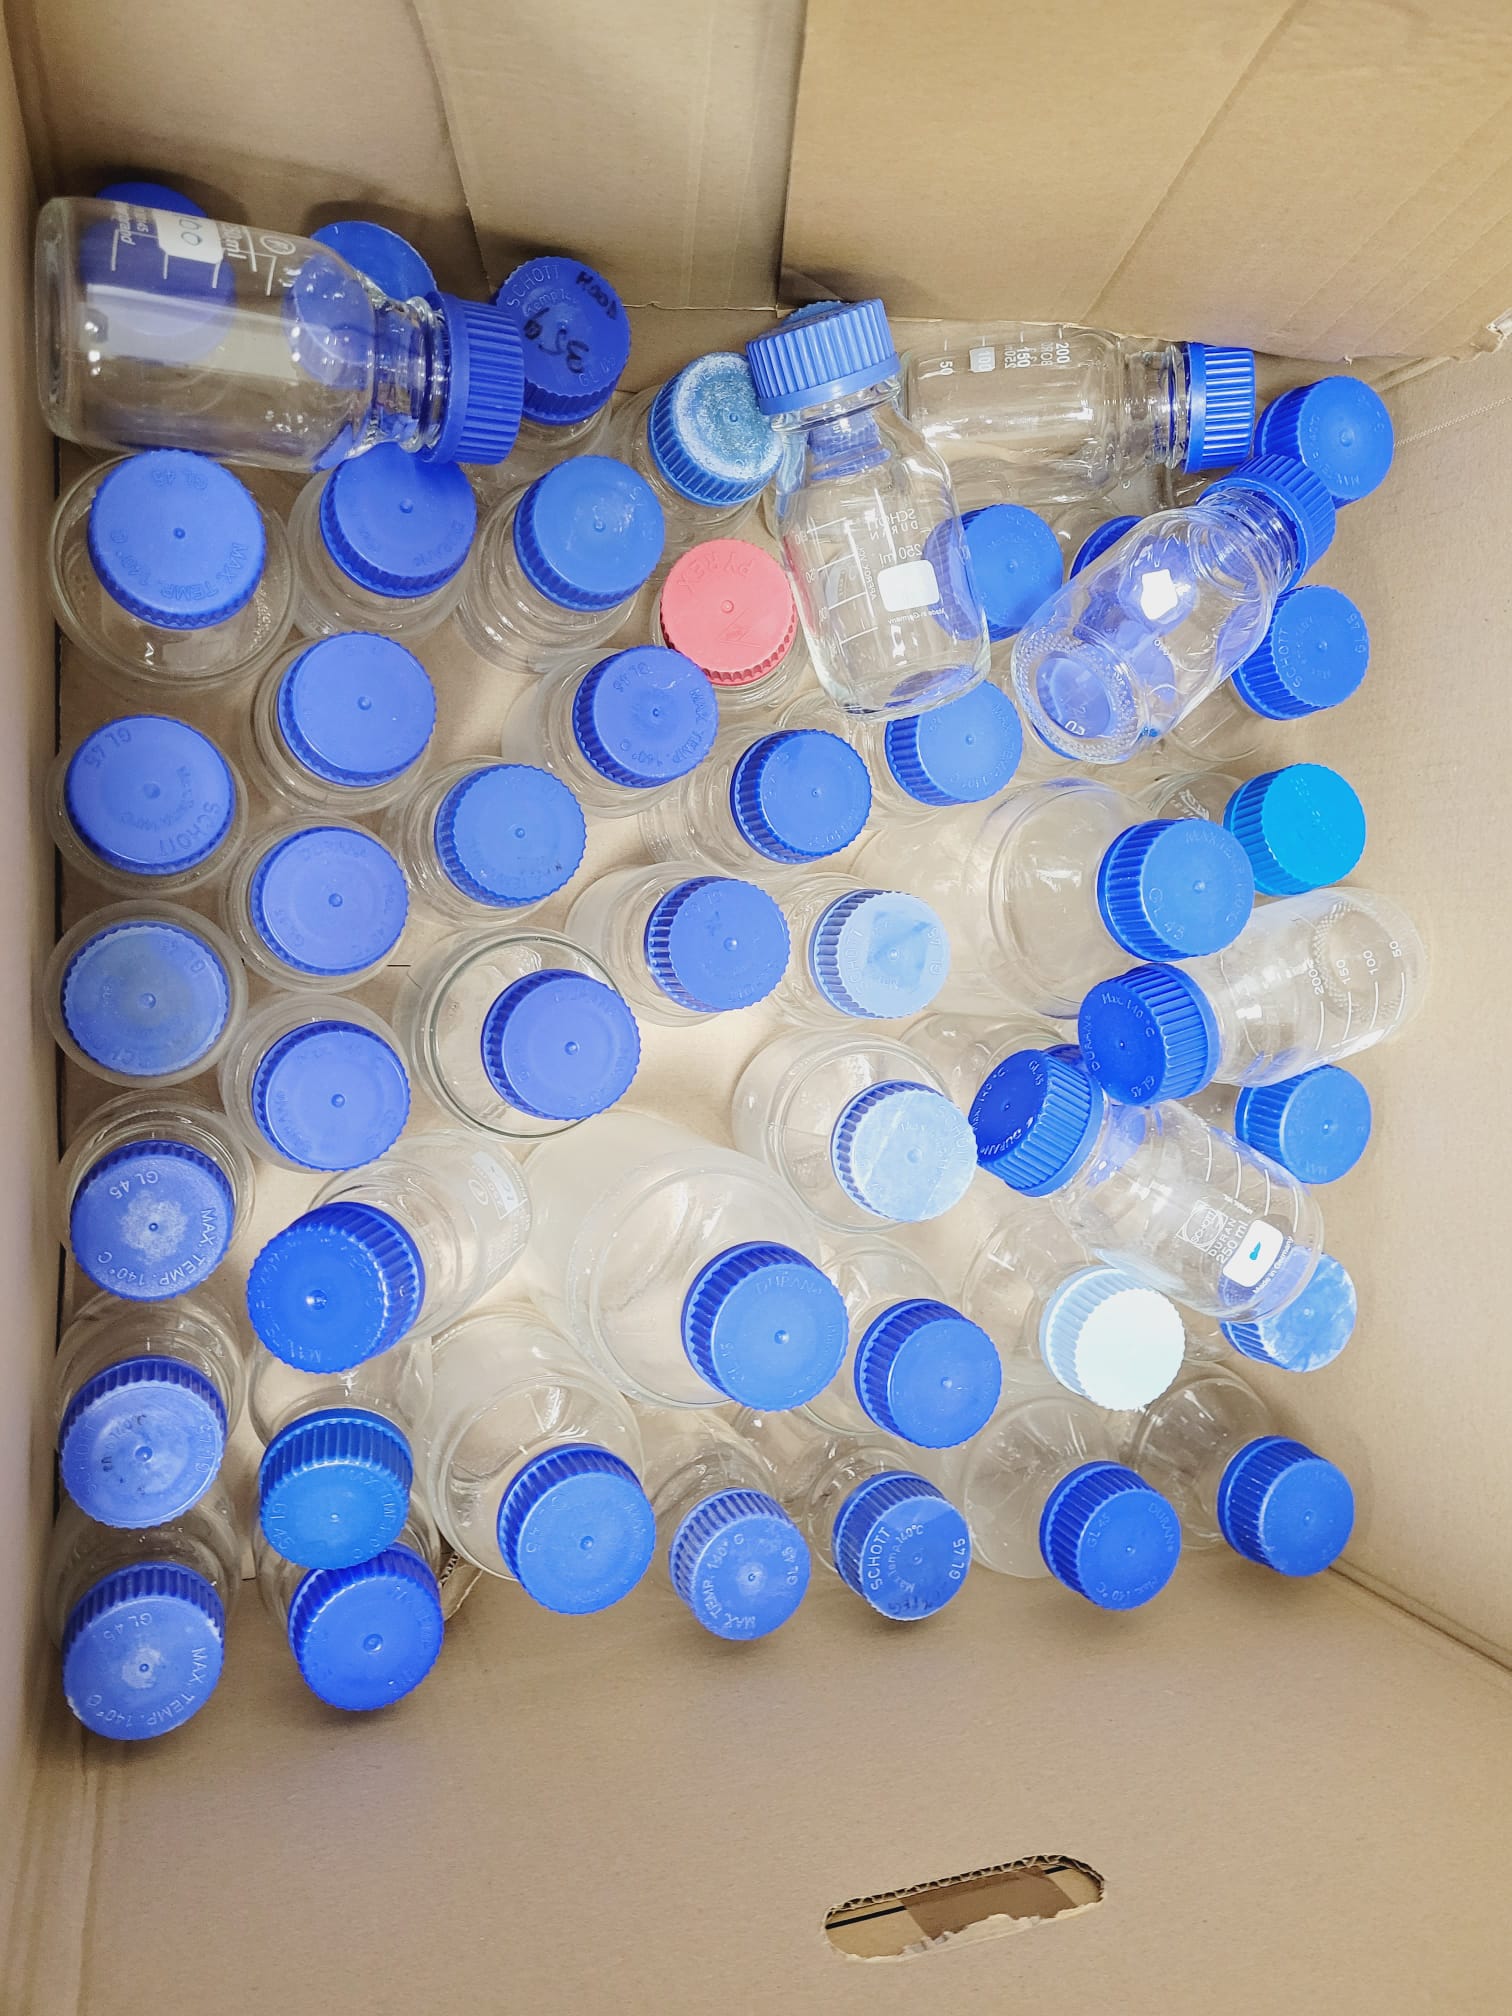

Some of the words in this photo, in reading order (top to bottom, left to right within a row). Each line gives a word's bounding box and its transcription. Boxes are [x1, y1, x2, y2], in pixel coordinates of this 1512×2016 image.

[507, 265, 560, 307] SCHOTT
[1017, 346, 1031, 368] 150
[1056, 342, 1071, 365] 200
[676, 551, 755, 594] PYREX
[1275, 629, 1303, 689] SCHOTT
[158, 801, 222, 857] SCHOTT
[1388, 939, 1403, 959] 50
[1334, 958, 1352, 985] 150
[1362, 949, 1381, 976] 100
[1307, 968, 1325, 996] 200
[134, 1169, 160, 1186] GL
[108, 1181, 132, 1200] 45
[1207, 1217, 1237, 1257] DURAN
[1216, 1238, 1239, 1264] 250
[1235, 1220, 1249, 1241] ml
[97, 1251, 114, 1266] C
[952, 1537, 967, 1557] 45
[867, 1526, 891, 1591] SCHOTT
[785, 1567, 800, 1586] GL
[947, 1562, 966, 1581] GL
[102, 1622, 122, 1640] 45
[127, 1611, 154, 1629] GL
[86, 1693, 103, 1709] C
